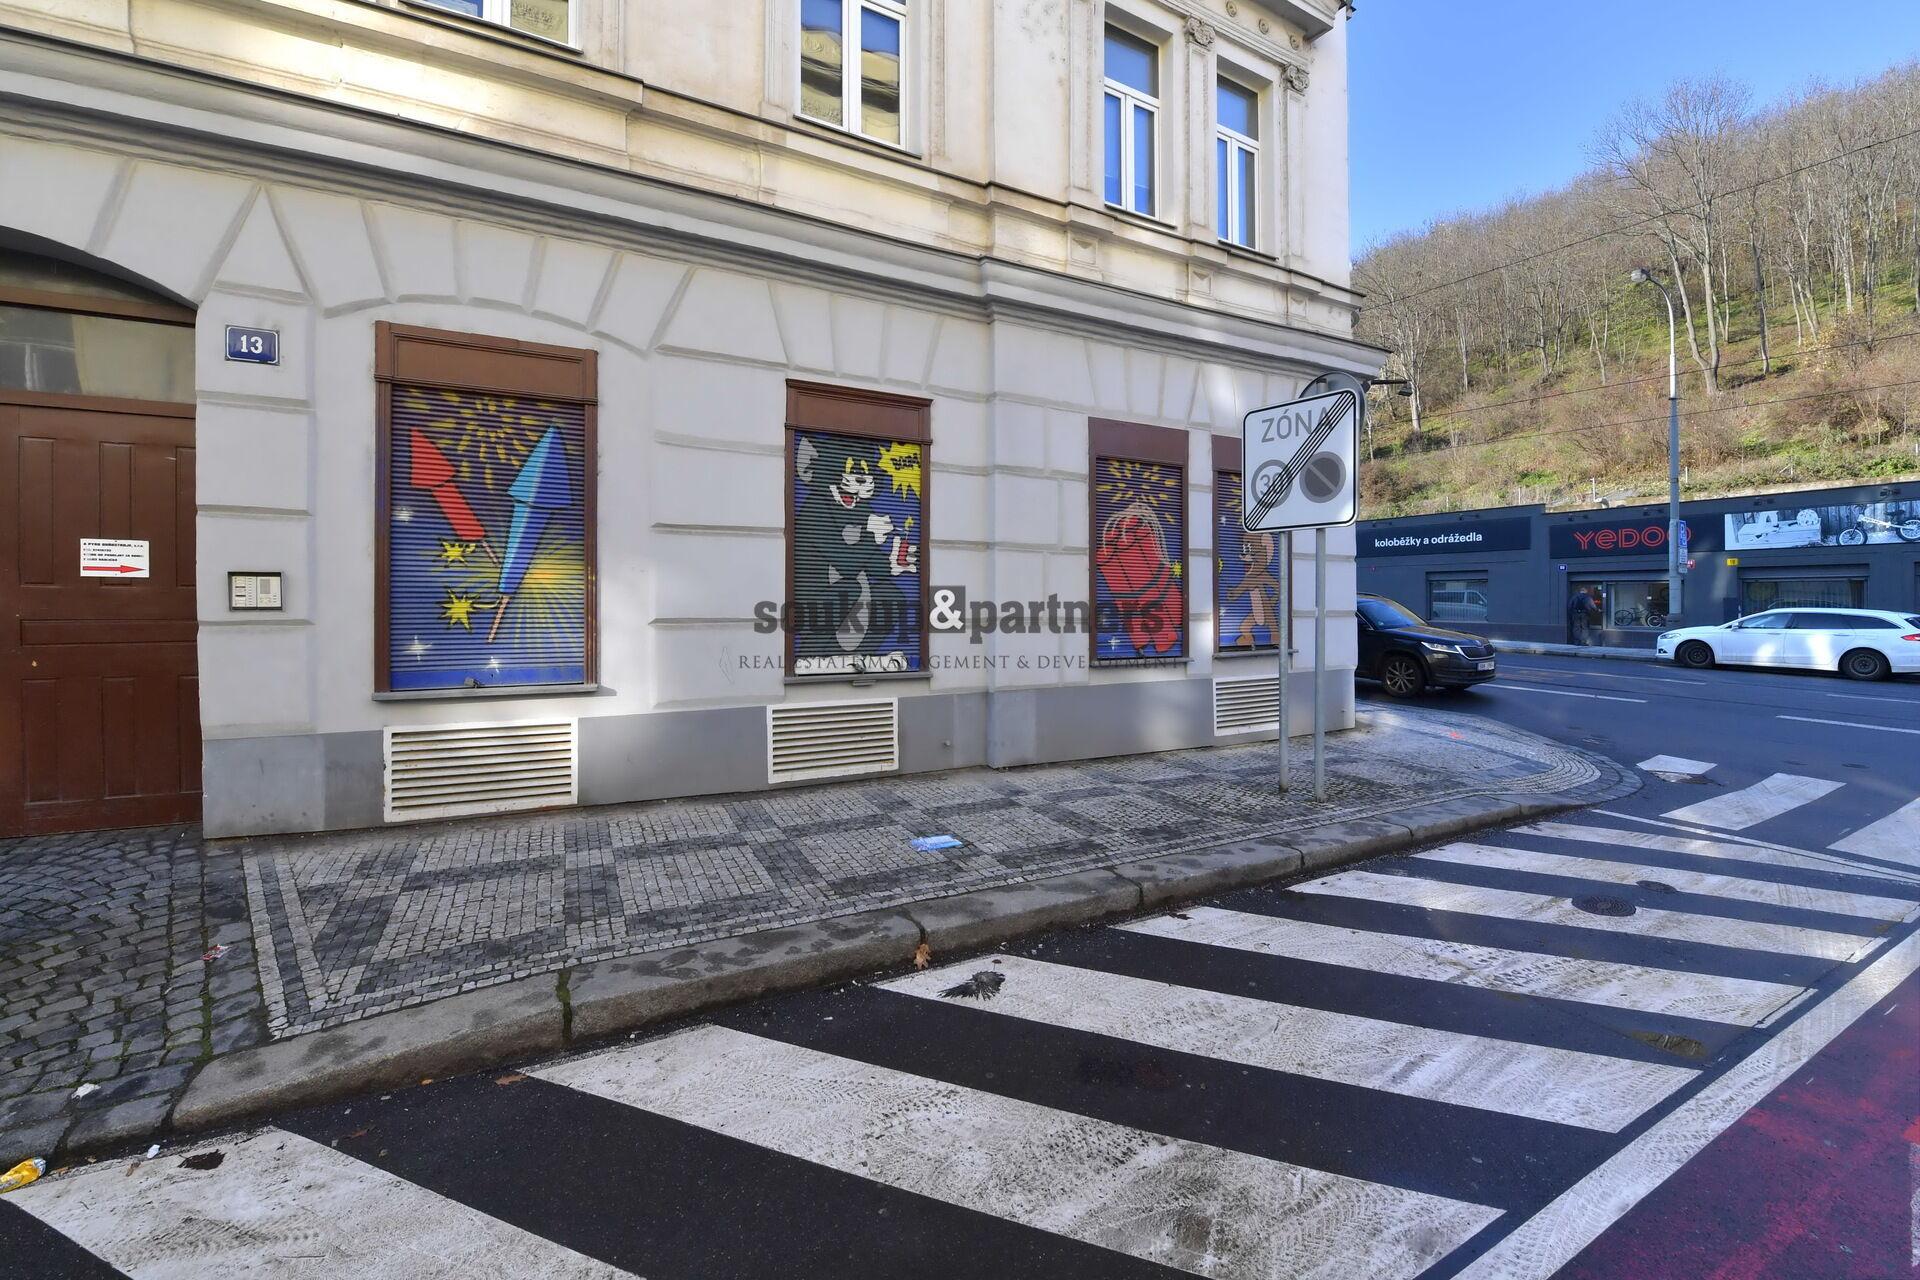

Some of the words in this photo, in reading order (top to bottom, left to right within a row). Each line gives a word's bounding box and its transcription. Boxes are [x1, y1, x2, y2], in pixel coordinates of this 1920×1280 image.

[240, 334, 263, 354] 13
[1261, 406, 1333, 443] ZÓNA
[1374, 536, 1421, 548] koloběžky
[1423, 537, 1429, 545] a
[1431, 532, 1483, 544] odrážedla
